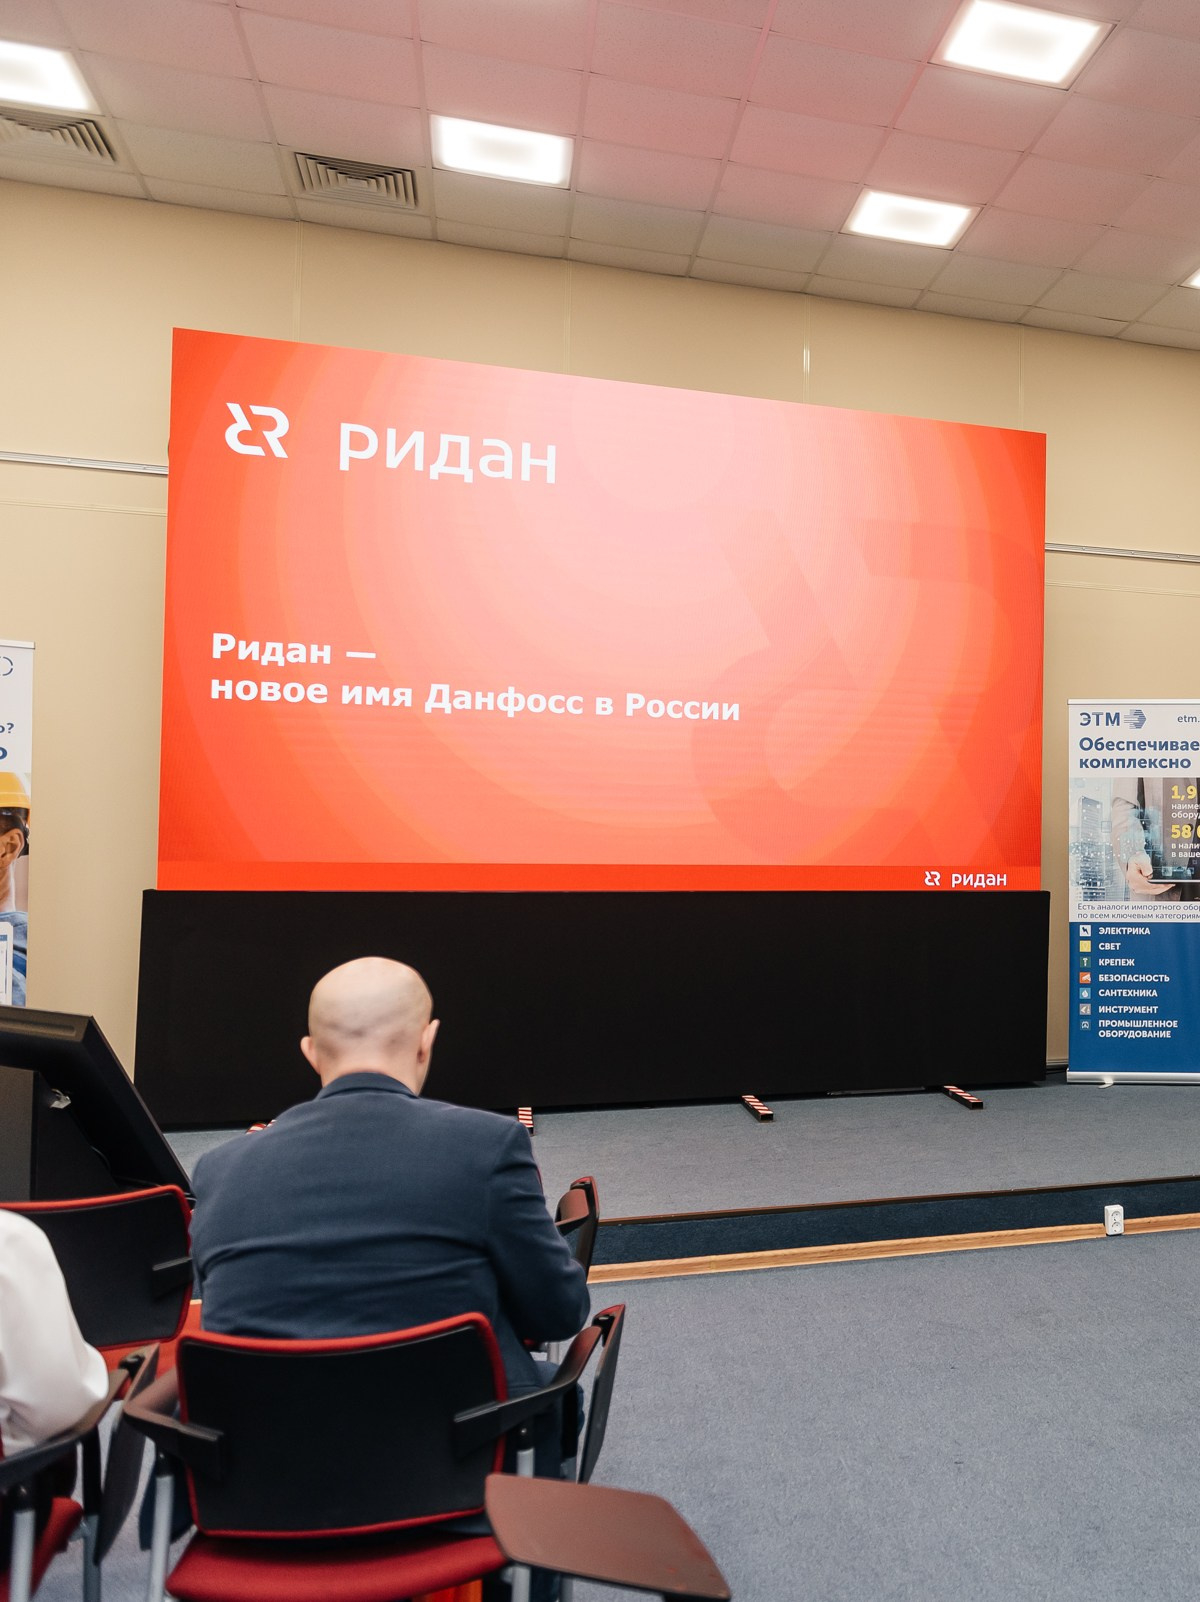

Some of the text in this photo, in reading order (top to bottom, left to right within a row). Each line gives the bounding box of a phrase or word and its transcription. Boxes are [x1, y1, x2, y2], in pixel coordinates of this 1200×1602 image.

[339, 422, 557, 484] ридан
[212, 632, 332, 667] Ридан
[210, 677, 740, 722] новое имя Данфосс в России
[1079, 712, 1120, 727] ЭТМ
[1079, 758, 1192, 769] комплексно
[1171, 785, 1197, 800] 1,9
[1171, 824, 1192, 839] 58
[951, 873, 1007, 888] ридан
[1077, 903, 1095, 911] Есть
[1131, 904, 1181, 912] импортного
[1098, 927, 1151, 935] ЭЛЕКТРИКА
[1098, 942, 1121, 951] СВЕТ
[1098, 958, 1135, 967] КРЕПЕЖ
[1098, 974, 1170, 983] БЕЗОПАСНОСТЬ
[1098, 989, 1158, 998] САНТЕХНИКА
[1098, 1005, 1159, 1014] ИНСТРУМЕНТ
[1098, 1019, 1179, 1028] ПРОМЫШЛЕННОЕ
[1098, 1030, 1172, 1039] ОБОРУДОВАНИЕ
